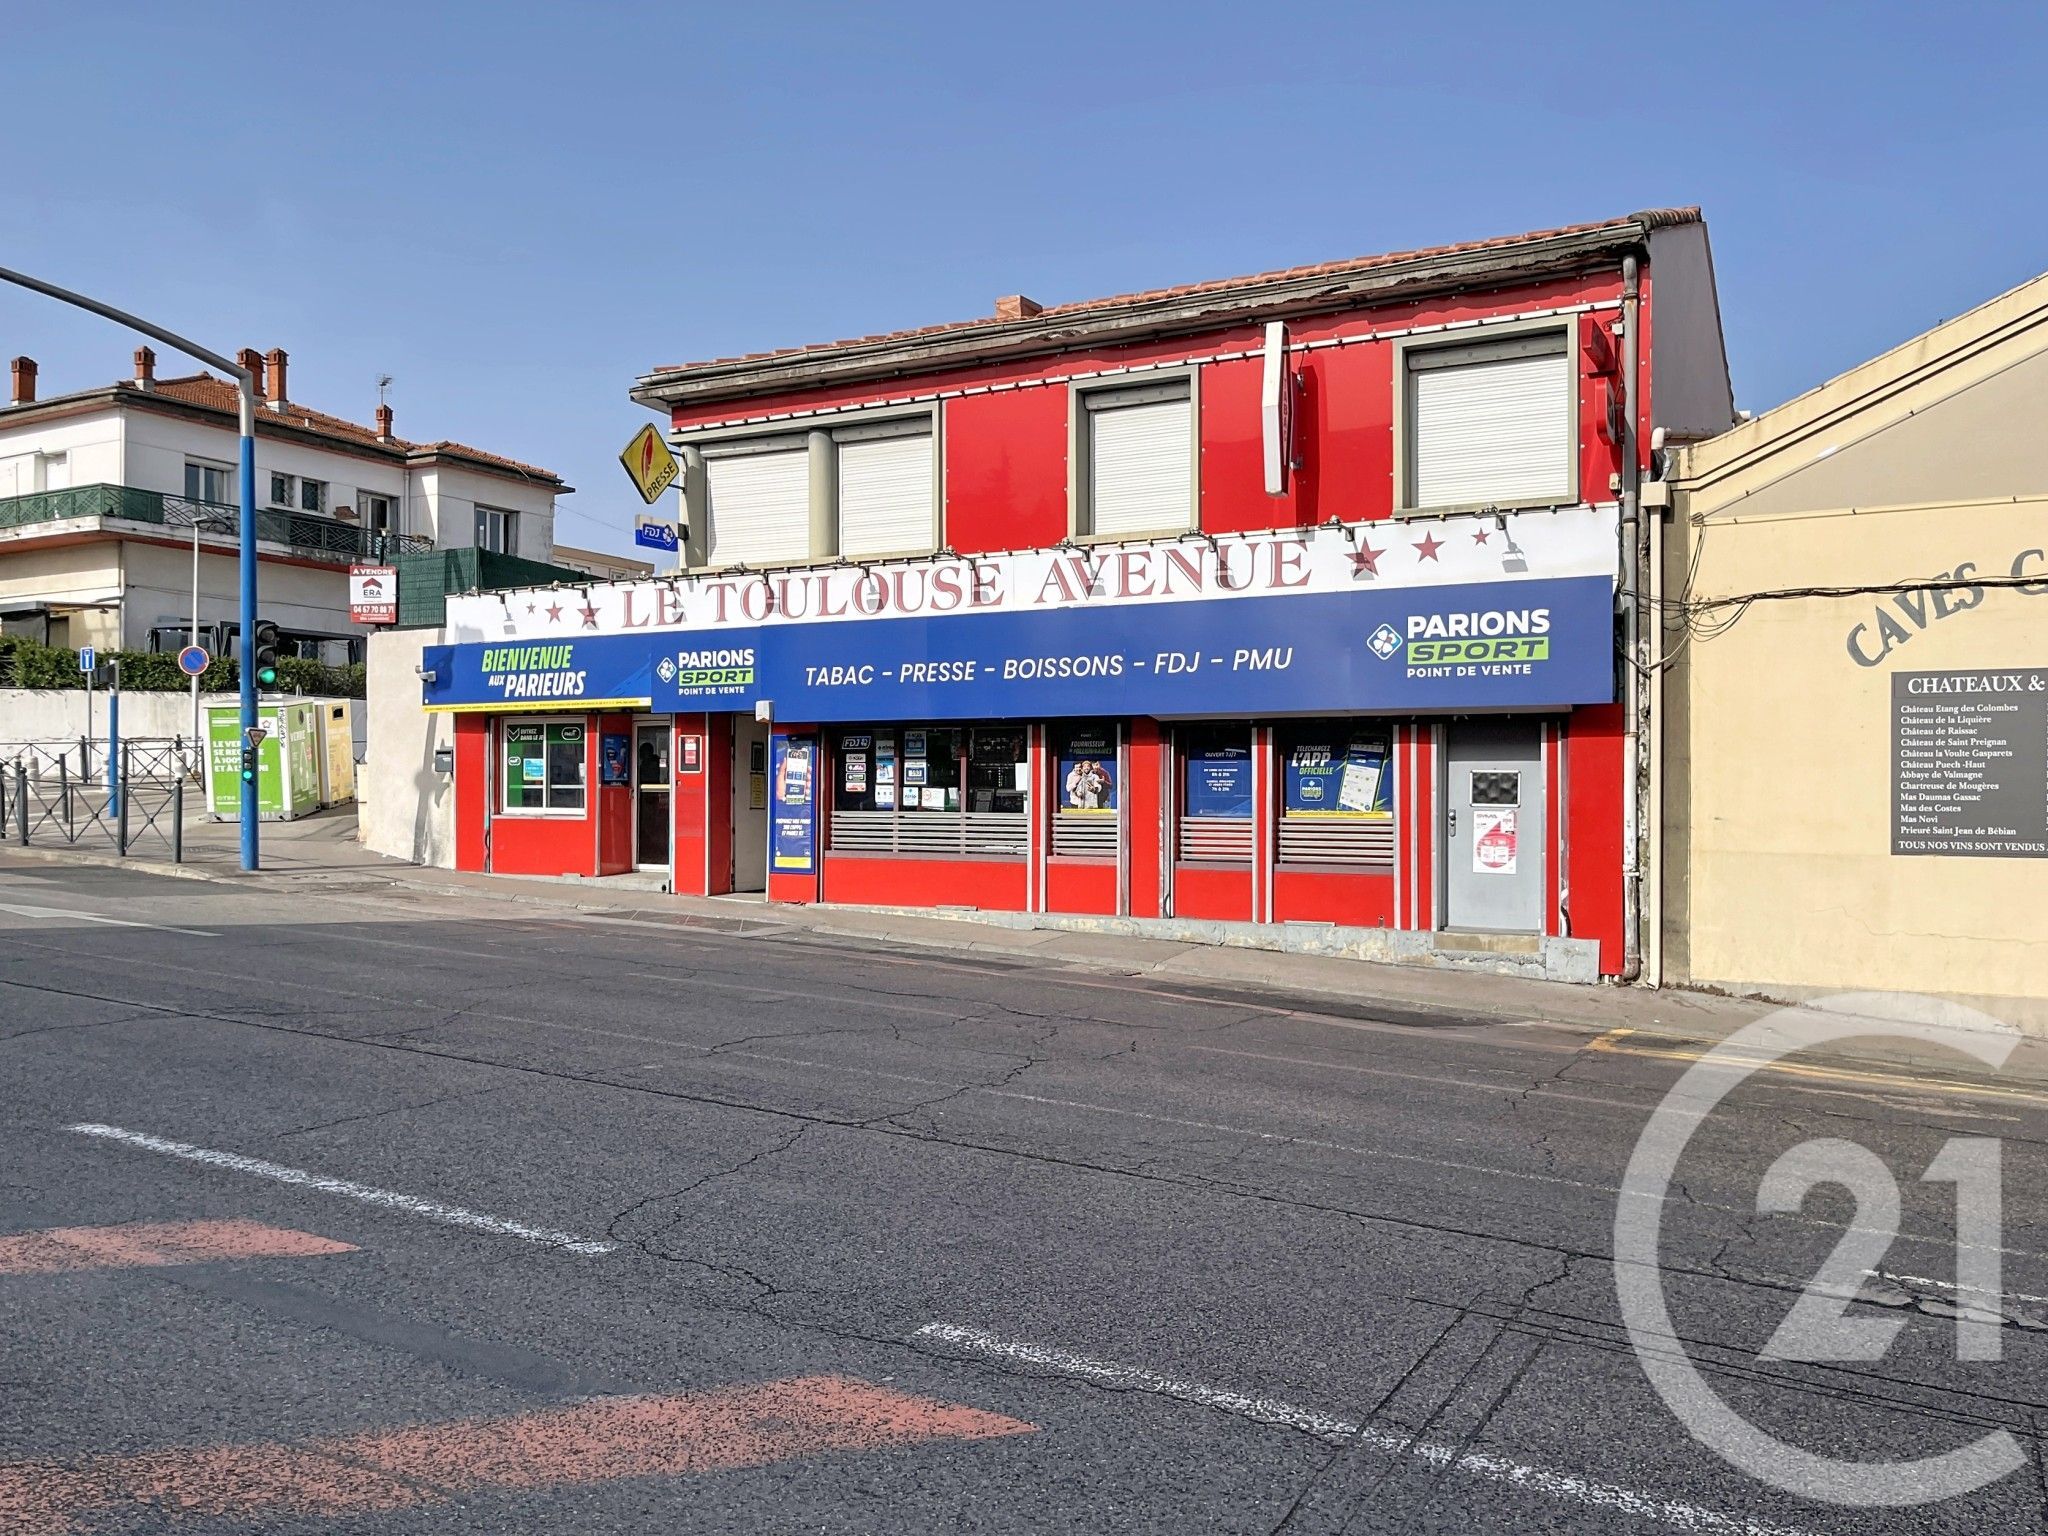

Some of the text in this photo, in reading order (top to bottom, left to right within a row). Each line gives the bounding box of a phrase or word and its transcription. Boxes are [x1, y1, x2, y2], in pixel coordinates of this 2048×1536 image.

[646, 462, 675, 498] PRESSE
[644, 527, 660, 538] FDJ
[621, 540, 1312, 629] LE TOULOUSE AVENUE
[1846, 562, 1985, 667] CAVES
[1407, 609, 1550, 639] PARIONS
[1412, 640, 1545, 662] SPORT
[481, 645, 574, 673] BIENVENUE
[678, 649, 754, 669] PARIONS
[805, 665, 874, 687] TABAC
[900, 661, 976, 683] PRESSE
[1003, 655, 1124, 679] BOISSONS
[1154, 652, 1200, 674] FDJ
[1232, 648, 1293, 671] PMU
[1407, 664, 1532, 678] POINT DE VENTE
[681, 670, 751, 684] SPORT
[488, 671, 587, 698] AUX PARIEURS
[1907, 675, 2045, 694] CHATEAUX &
[678, 686, 745, 696] POINT DE VENTE
[1936, 705, 1958, 714] Etang
[1977, 704, 2018, 712] Colombes
[1901, 716, 1992, 725] Château de la Liquière
[1936, 727, 1946, 735] de
[1948, 738, 1968, 746] Saint
[1970, 738, 2006, 747] Preignan
[1291, 752, 1331, 767] L'APP
[1901, 750, 1933, 758] Château
[1972, 749, 2012, 759] Gasparets
[1900, 771, 1929, 780] Abbaye
[1944, 771, 1983, 780] Valmagne
[1959, 782, 1999, 792] Mougères
[1900, 793, 1981, 801] Mas Daumas Gassac
[1900, 804, 1961, 812] Mas des Costes
[1900, 815, 1938, 823] Mas Novi
[1900, 826, 2016, 836] Prieuré Saint Jean de Bébian
[1899, 841, 2045, 851] TOUS NOS VINS SONT VENDUS
